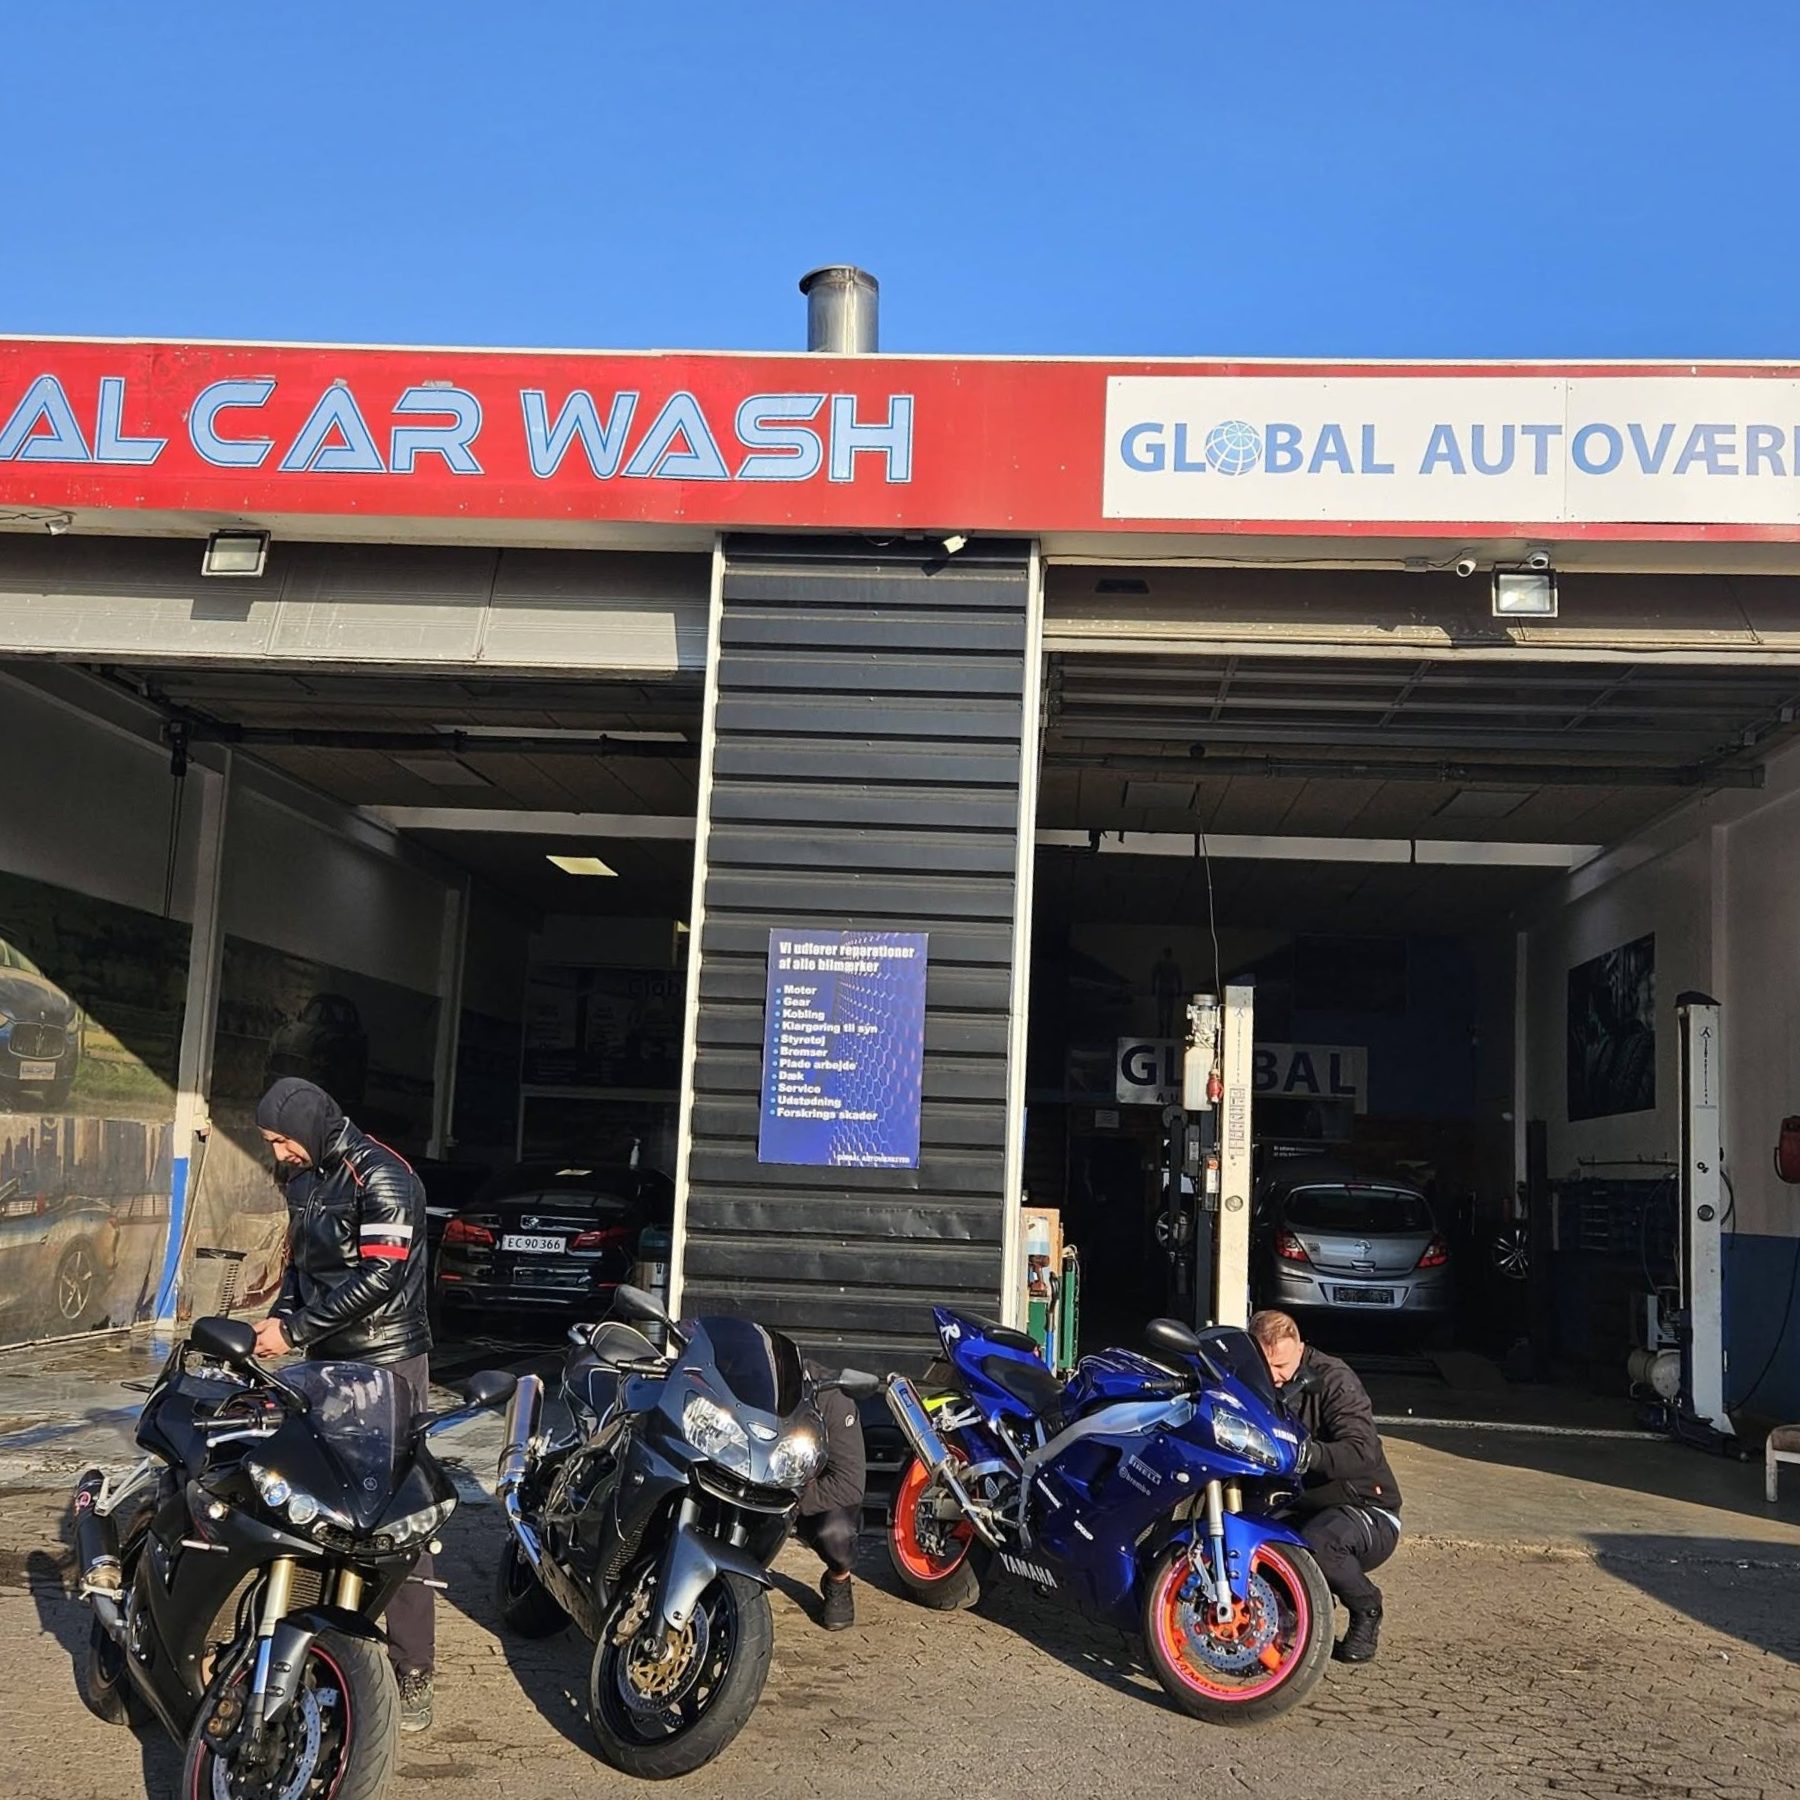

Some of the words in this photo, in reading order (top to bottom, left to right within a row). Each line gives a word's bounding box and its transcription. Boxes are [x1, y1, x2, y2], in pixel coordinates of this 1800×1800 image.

[188, 379, 484, 475] CAR
[520, 389, 914, 483] WASH
[1120, 420, 1395, 476] GLOBAL
[1419, 423, 1800, 477] AUTOVÆR
[779, 942, 792, 954] Vi
[840, 945, 915, 958] reparationer
[779, 958, 791, 969] af
[793, 958, 816, 970] alle
[783, 985, 817, 995] Motor
[783, 997, 811, 1006] Gear
[782, 1009, 825, 1021] Kobling
[843, 1023, 855, 1033] til
[857, 1025, 878, 1035] syn
[780, 1046, 828, 1057] Bremser
[779, 1058, 811, 1068] Plade
[813, 1060, 857, 1071] arbejde
[1121, 1045, 1356, 1095] GLBAL
[778, 1071, 804, 1080] Dæk
[778, 1083, 821, 1093] Service
[838, 1110, 878, 1120] skader
[508, 1238, 522, 1248] EC
[525, 1239, 538, 1248] 90
[540, 1240, 560, 1249] 366
[1129, 1454, 1162, 1486] PIRELLI
[1125, 1473, 1151, 1496] brembo
[999, 1552, 1058, 1589] YAMAHA
